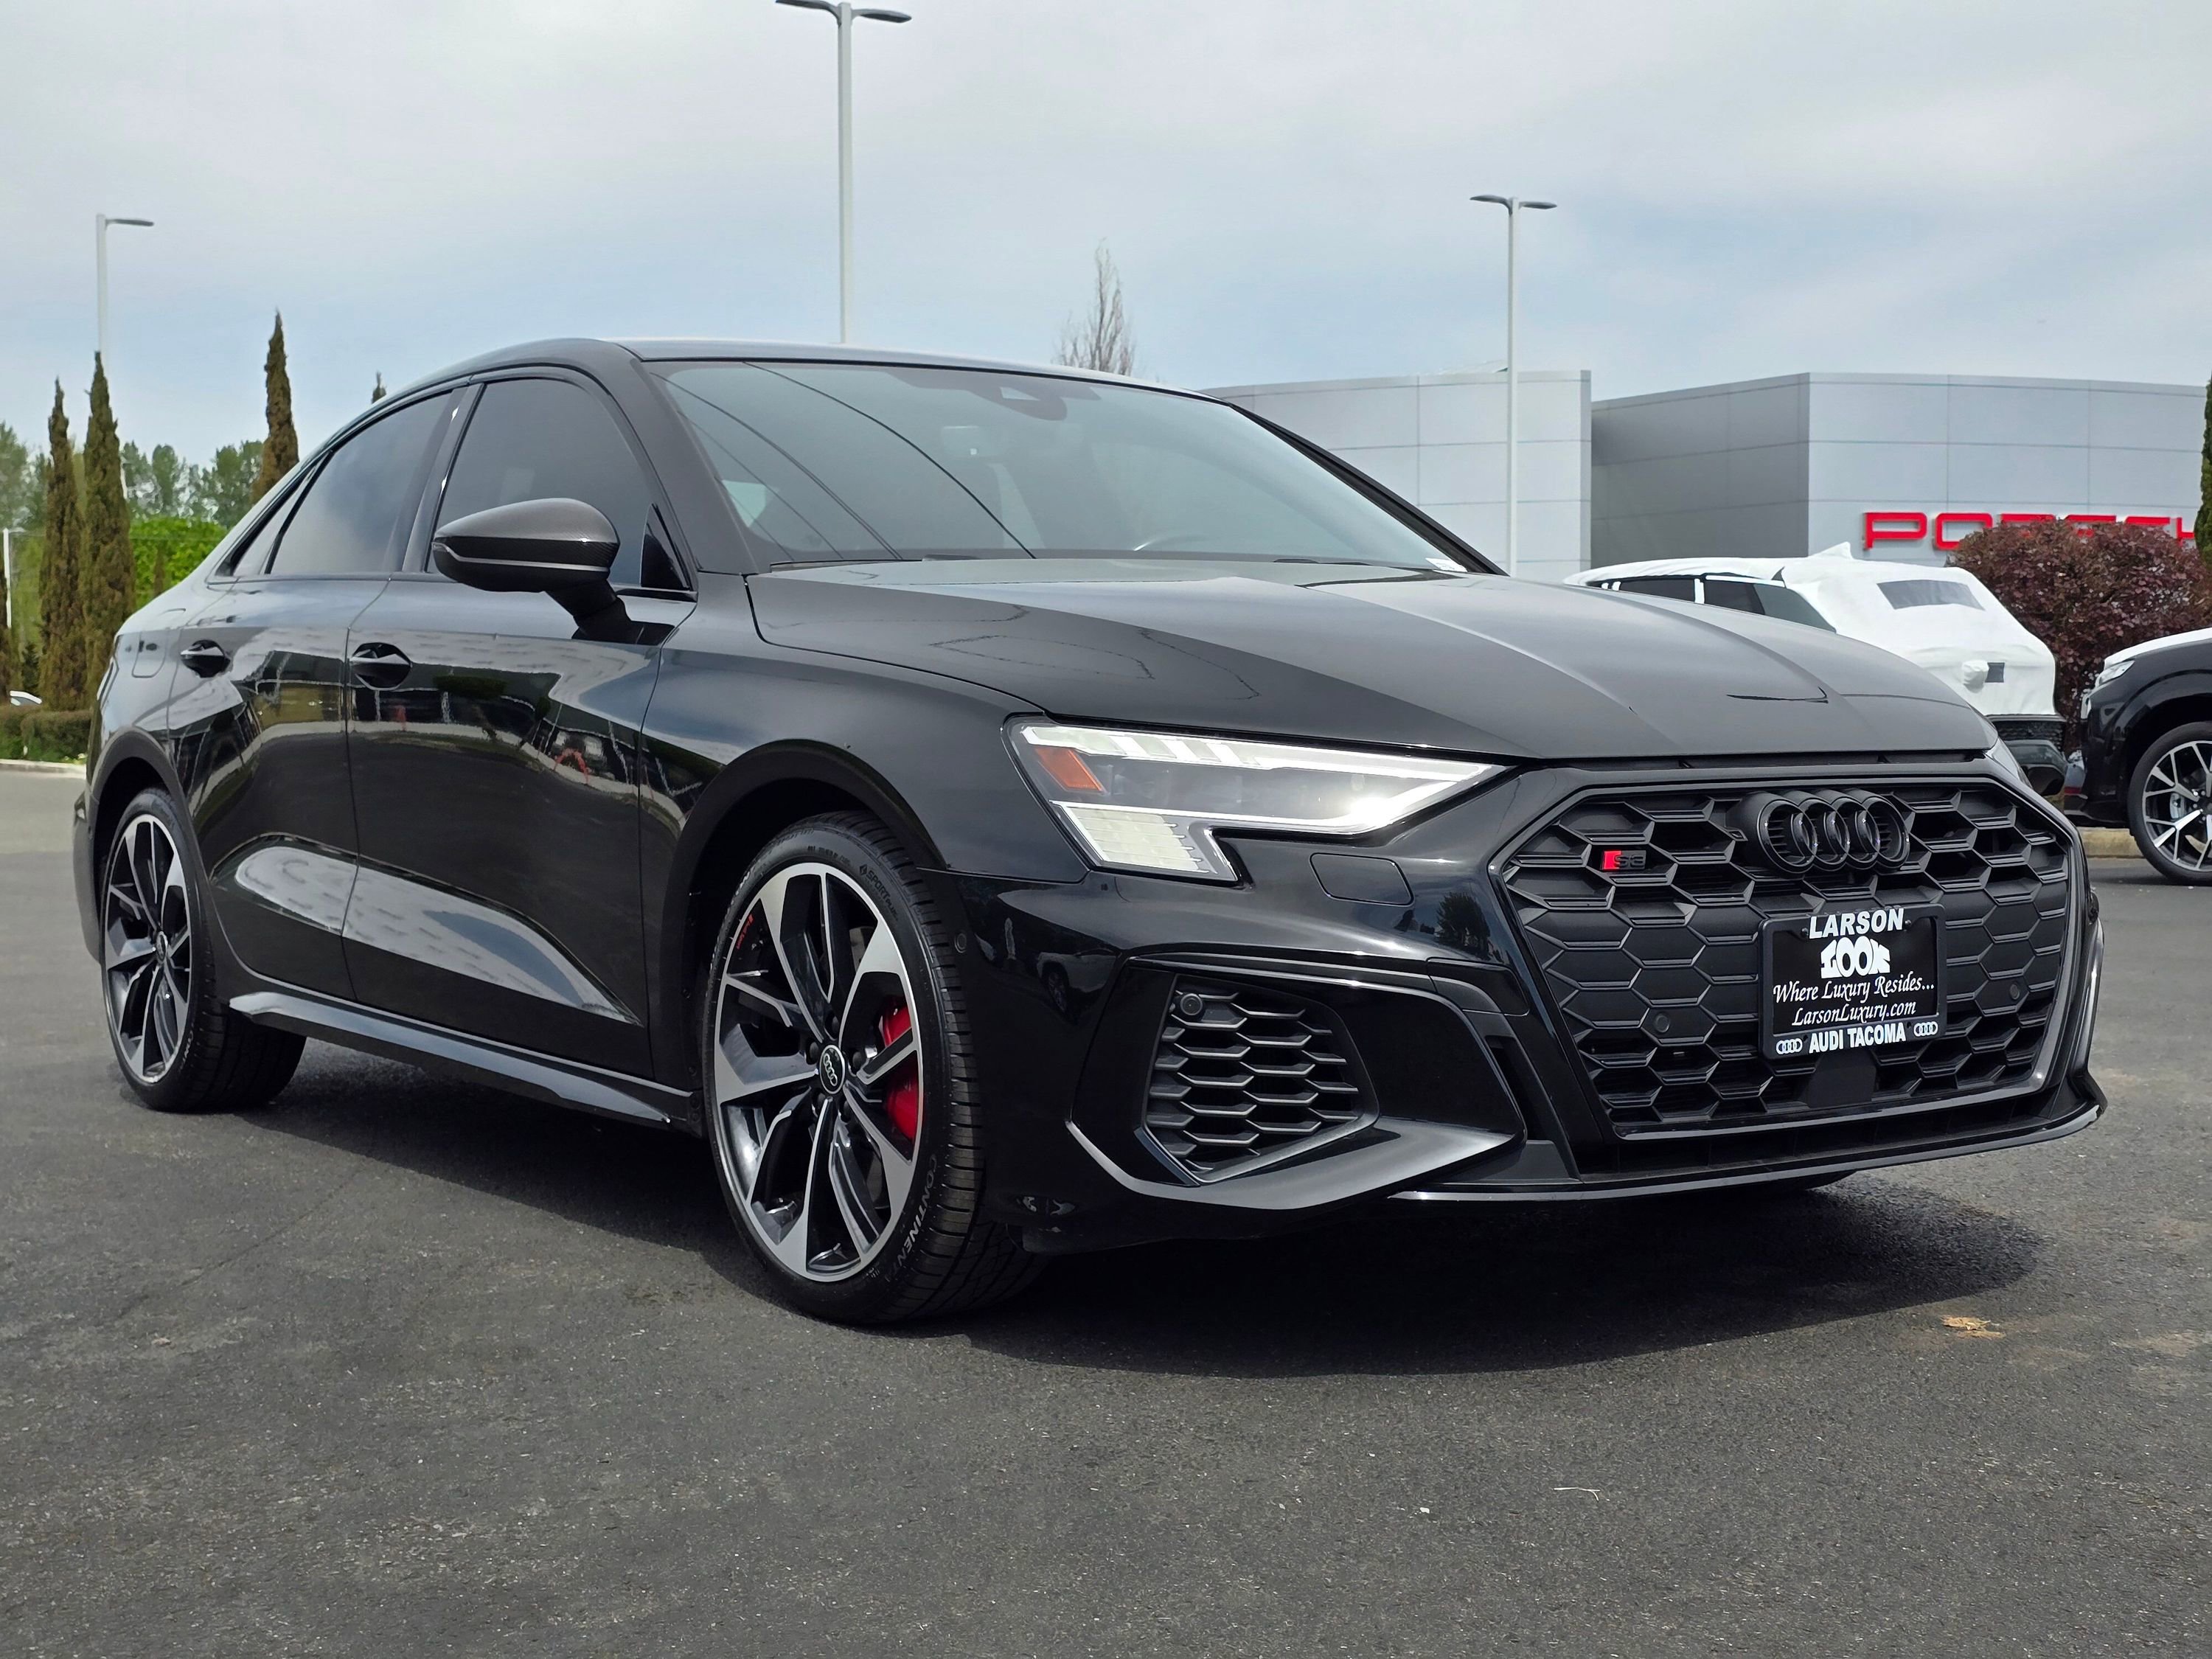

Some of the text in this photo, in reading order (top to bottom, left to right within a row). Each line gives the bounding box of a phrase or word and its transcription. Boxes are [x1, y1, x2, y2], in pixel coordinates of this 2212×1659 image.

[1809, 908, 1904, 939] LARSON
[1773, 971, 1935, 1004] Where Luxury Resides...
[1791, 1001, 1917, 1026] LarsonLuxury.com
[1809, 1023, 1907, 1054] AUDI TACOMA
